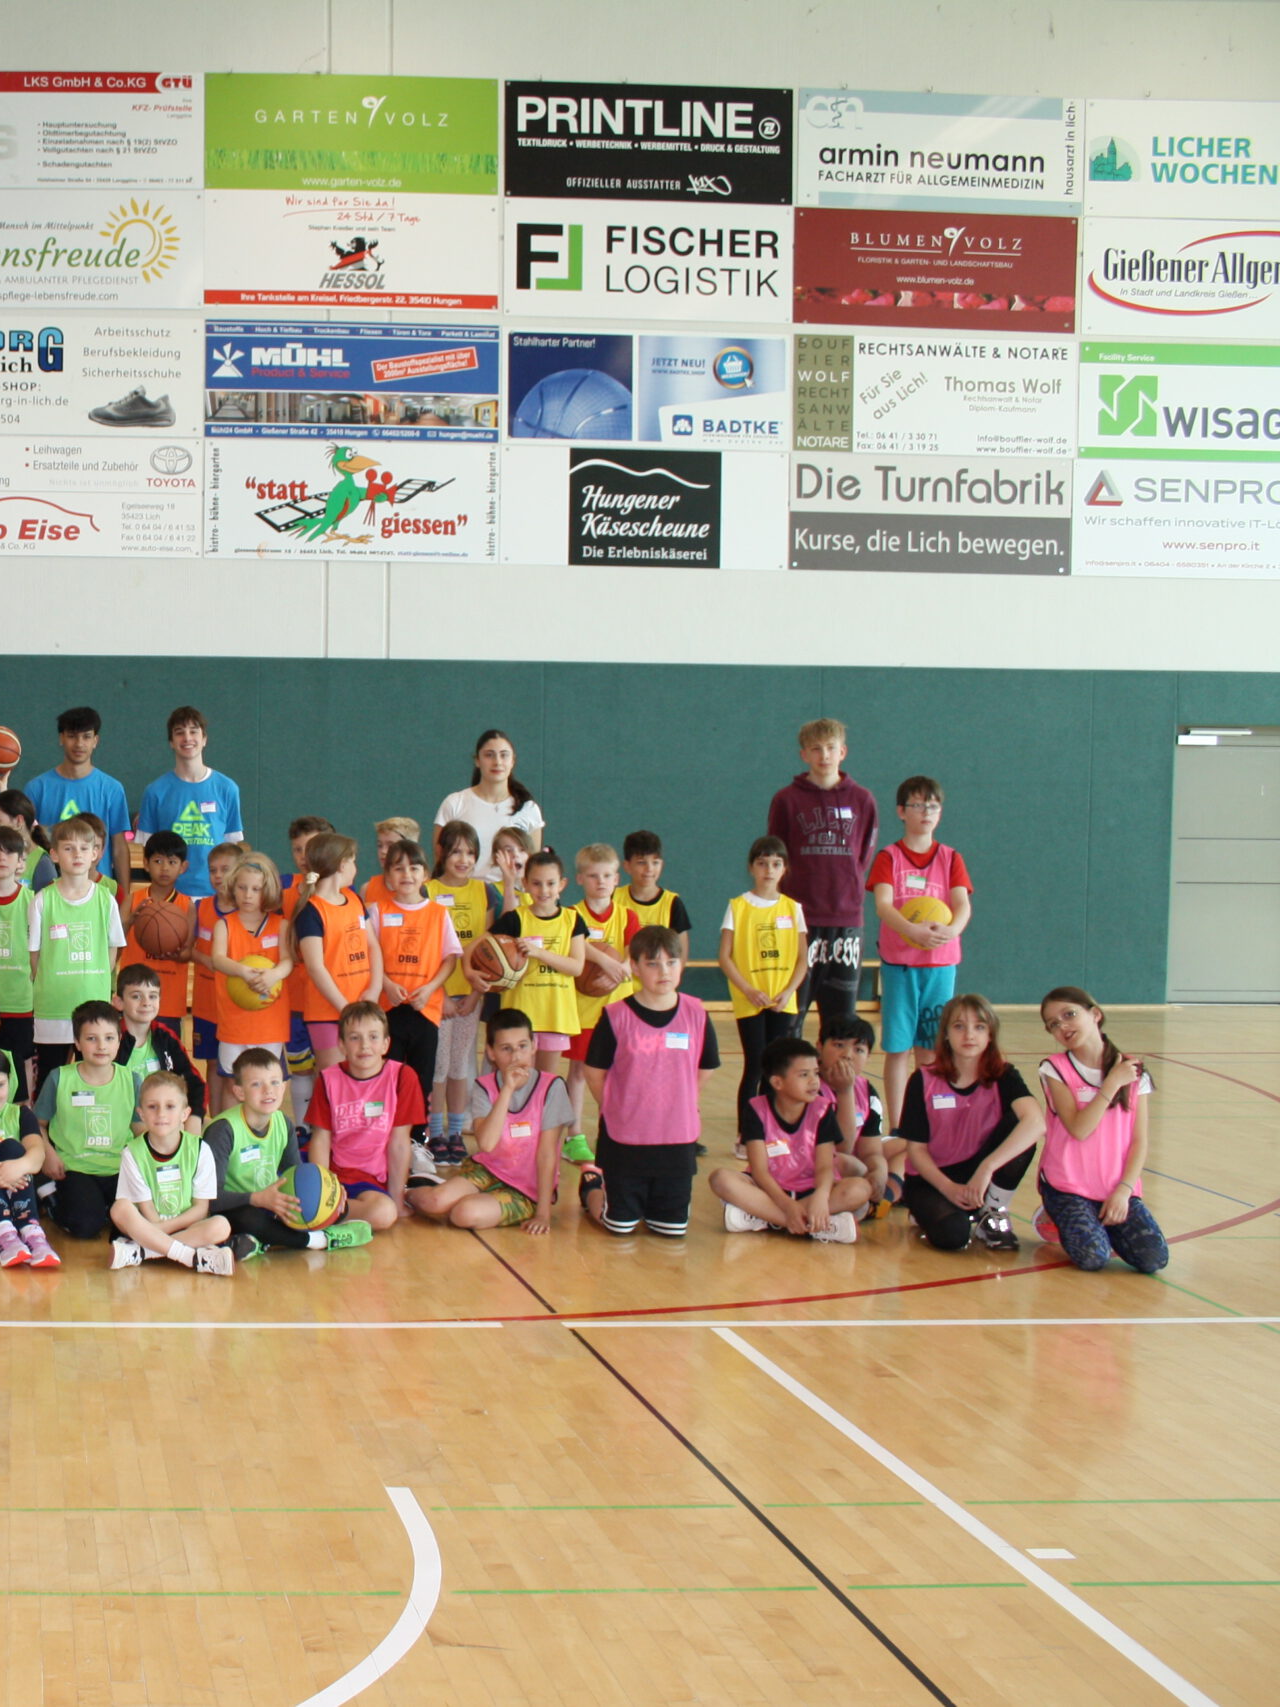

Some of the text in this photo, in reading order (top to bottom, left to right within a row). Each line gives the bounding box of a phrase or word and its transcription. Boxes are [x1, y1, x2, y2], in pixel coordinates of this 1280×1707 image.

[24, 77, 147, 89] LKS GmbH & Co.KG
[254, 110, 449, 126] GARTEN VOLZ
[517, 95, 754, 139] PRINTLINE
[517, 138, 567, 148] TEXTILDRUCK
[576, 140, 632, 150] WERBETECHNIK
[640, 141, 692, 152] WERBEMITTEL
[700, 143, 724, 153] DRUCK
[1152, 136, 1251, 158] LICHER
[818, 143, 1045, 174] armin neumann
[302, 176, 402, 188] www.garten-volz.de
[566, 177, 681, 191] OFFIZIELLER AUSSTATTER
[818, 170, 1044, 190] FACHARZT FÜR ALLGEMEINMEDIZIN
[606, 225, 779, 259] FISCHER
[850, 232, 1022, 250] BLUMEN VOLZ
[1103, 248, 1209, 283] Gießener
[319, 273, 386, 290] HESSOL
[606, 264, 779, 298] LOGISTIK
[896, 276, 974, 286] www.blumen-volz.de
[94, 326, 171, 338] Arbeitsschutz
[513, 336, 596, 349] Stahlharter Partner!
[83, 347, 181, 361] Berufsbekleidung
[251, 342, 350, 368] MÜHL
[858, 342, 1068, 360] RECHTSANWÄLTE & NOTARE
[82, 368, 182, 379] Sicherheitsschuhe
[798, 370, 850, 382] WOLF
[944, 376, 1062, 395] Thomas Wolf
[703, 419, 779, 435] BADTKE
[796, 436, 849, 448] NOTARE
[33, 445, 82, 457] Leihwagen
[146, 478, 196, 488] TOYOTA
[796, 462, 1065, 506] Die Turnfabrik
[581, 485, 681, 515] Hungener
[18, 519, 81, 541] Eise
[581, 513, 710, 539] Käsescheune
[1084, 516, 1245, 529] Wir schaffen innovative
[794, 528, 1065, 560] Kurse, die Lich bewegen.
[1163, 540, 1260, 552] www.senpro.it
[582, 545, 707, 561] Die Erlebniskäserei
[69, 951, 93, 962] DBB
[86, 1135, 111, 1148] DBB
